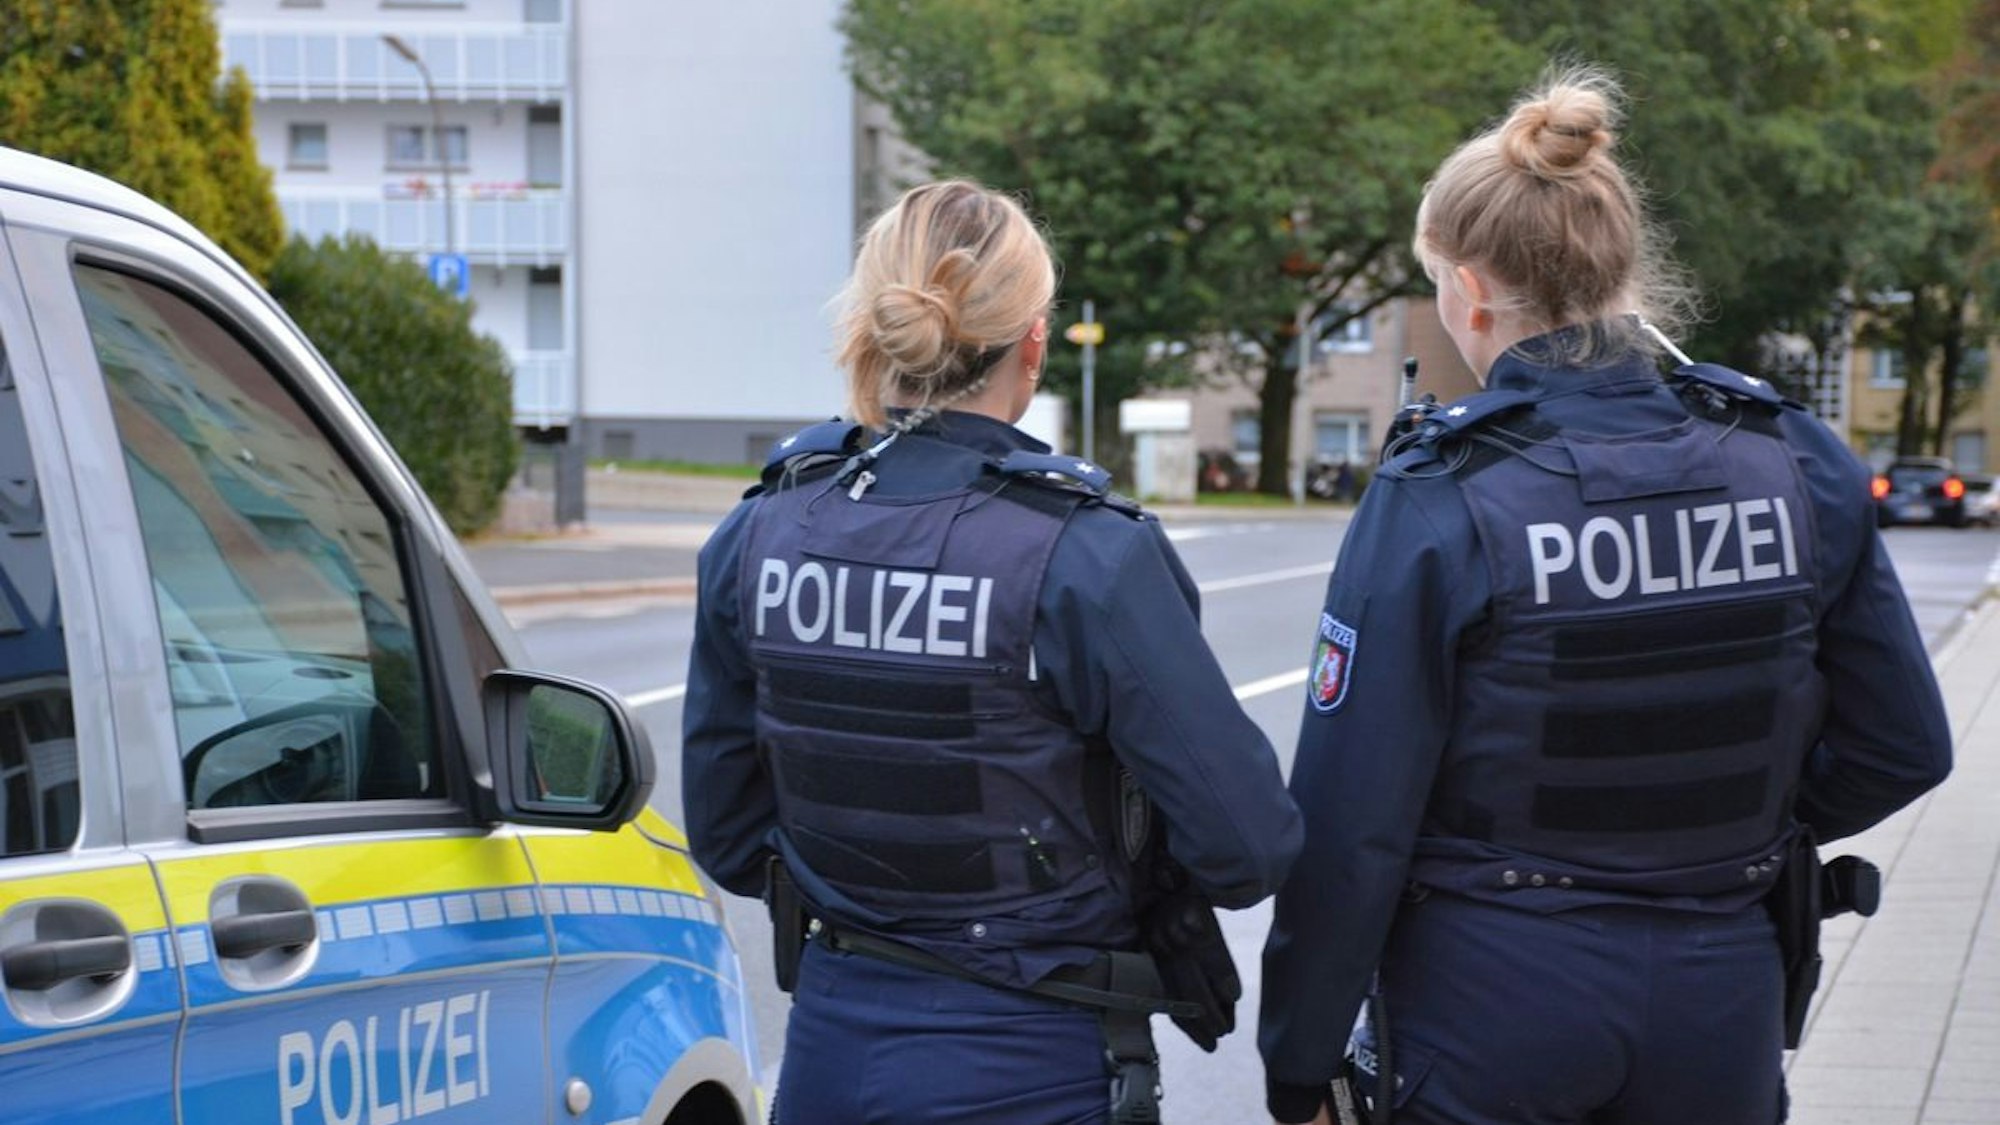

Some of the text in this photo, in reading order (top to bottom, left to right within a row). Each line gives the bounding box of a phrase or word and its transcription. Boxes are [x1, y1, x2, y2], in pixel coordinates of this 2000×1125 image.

[437, 258, 459, 290] P
[1526, 497, 1799, 605] POLIZEI
[755, 558, 994, 658] POLIZEI
[278, 990, 490, 1125] POLIZEI
